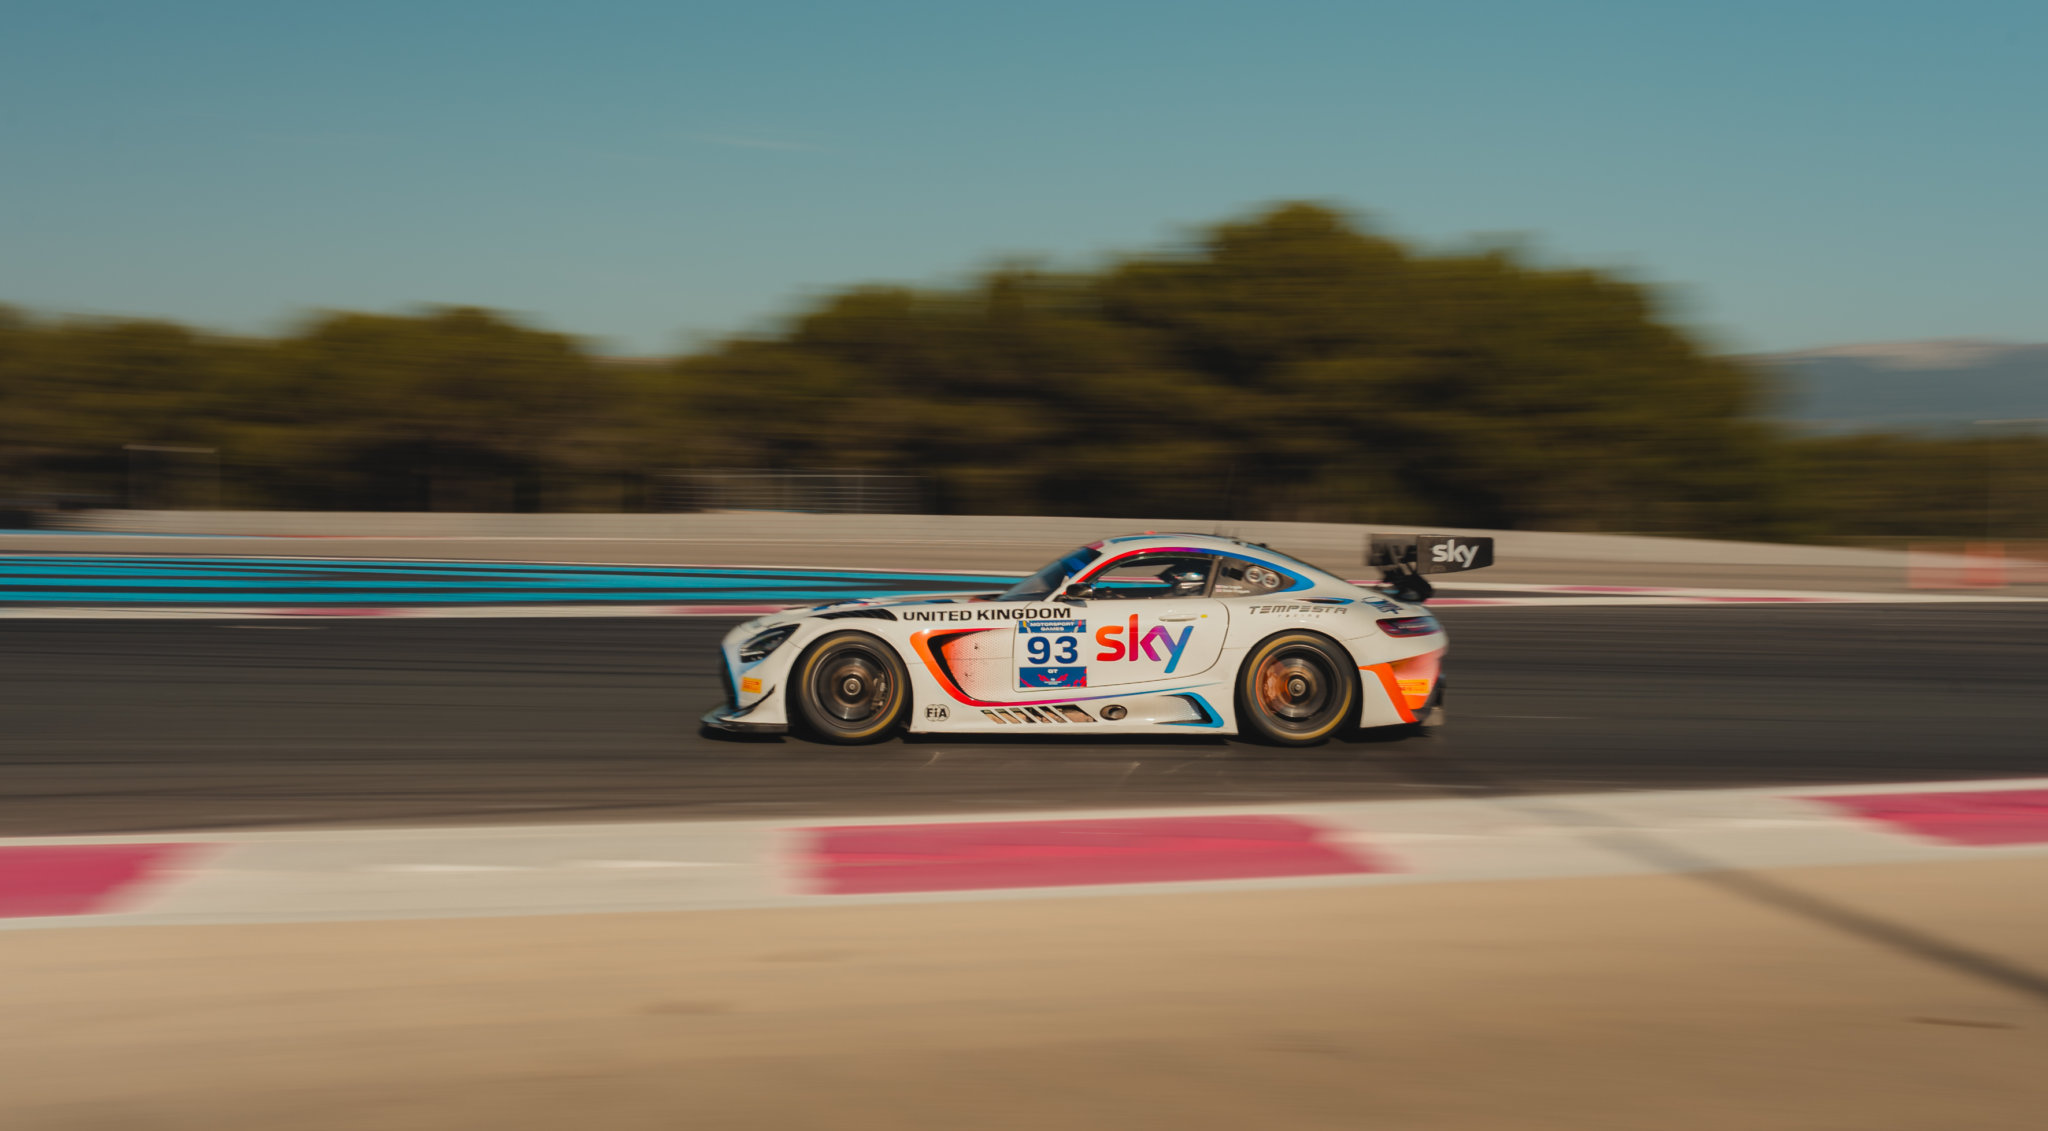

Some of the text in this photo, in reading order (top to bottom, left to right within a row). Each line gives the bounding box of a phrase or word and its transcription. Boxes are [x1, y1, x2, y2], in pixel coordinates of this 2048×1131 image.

[1431, 539, 1479, 568] sky
[903, 608, 1071, 621] UNITED KINGDOM
[1249, 605, 1348, 615] TEMPESTA
[1027, 635, 1078, 665] 93
[1095, 613, 1194, 674] sky
